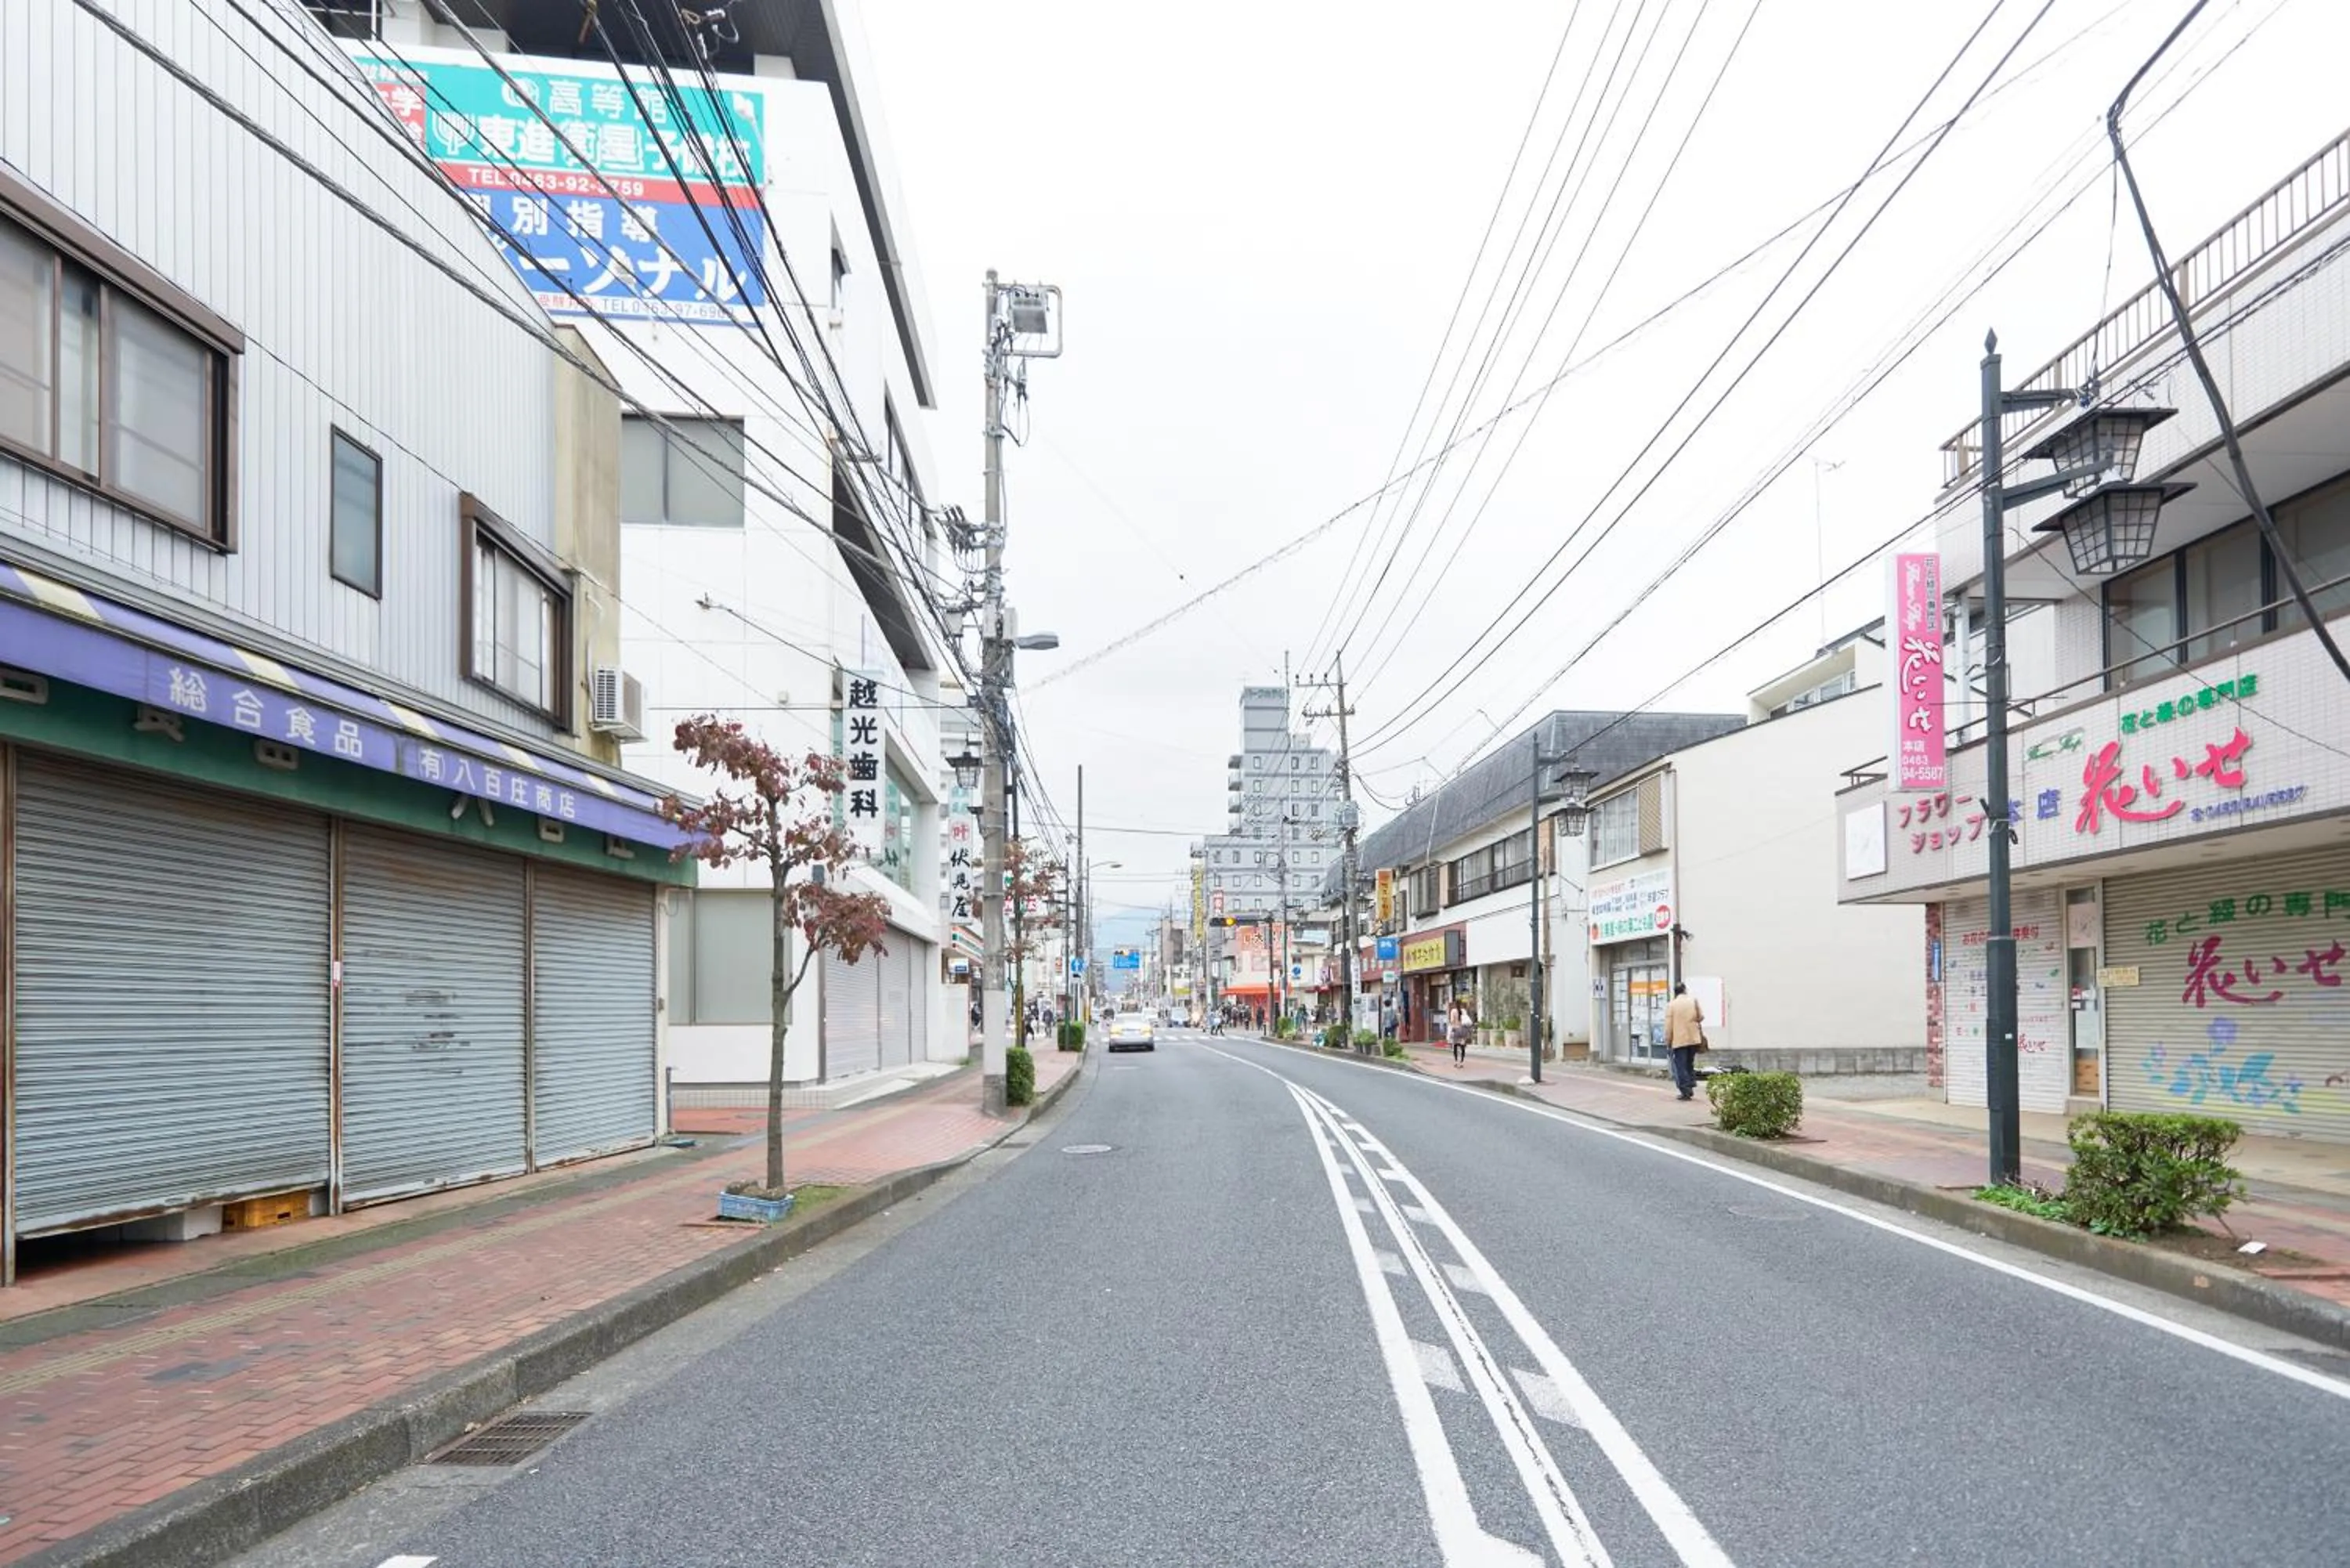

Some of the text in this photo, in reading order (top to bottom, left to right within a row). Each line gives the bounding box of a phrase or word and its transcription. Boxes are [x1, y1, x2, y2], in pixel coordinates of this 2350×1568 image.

[549, 81, 667, 124] 高等館
[468, 168, 505, 186] TEL
[492, 235, 747, 302] ーソナル
[169, 667, 363, 758] 総合食品
[849, 679, 879, 819] 越光歯科
[2075, 725, 2254, 835] 花いせ
[1899, 793, 1972, 829] フラワー
[1911, 814, 1987, 854] ショップ
[950, 848, 971, 916] 伏見屋
[2182, 934, 2347, 1009] 花いせ
